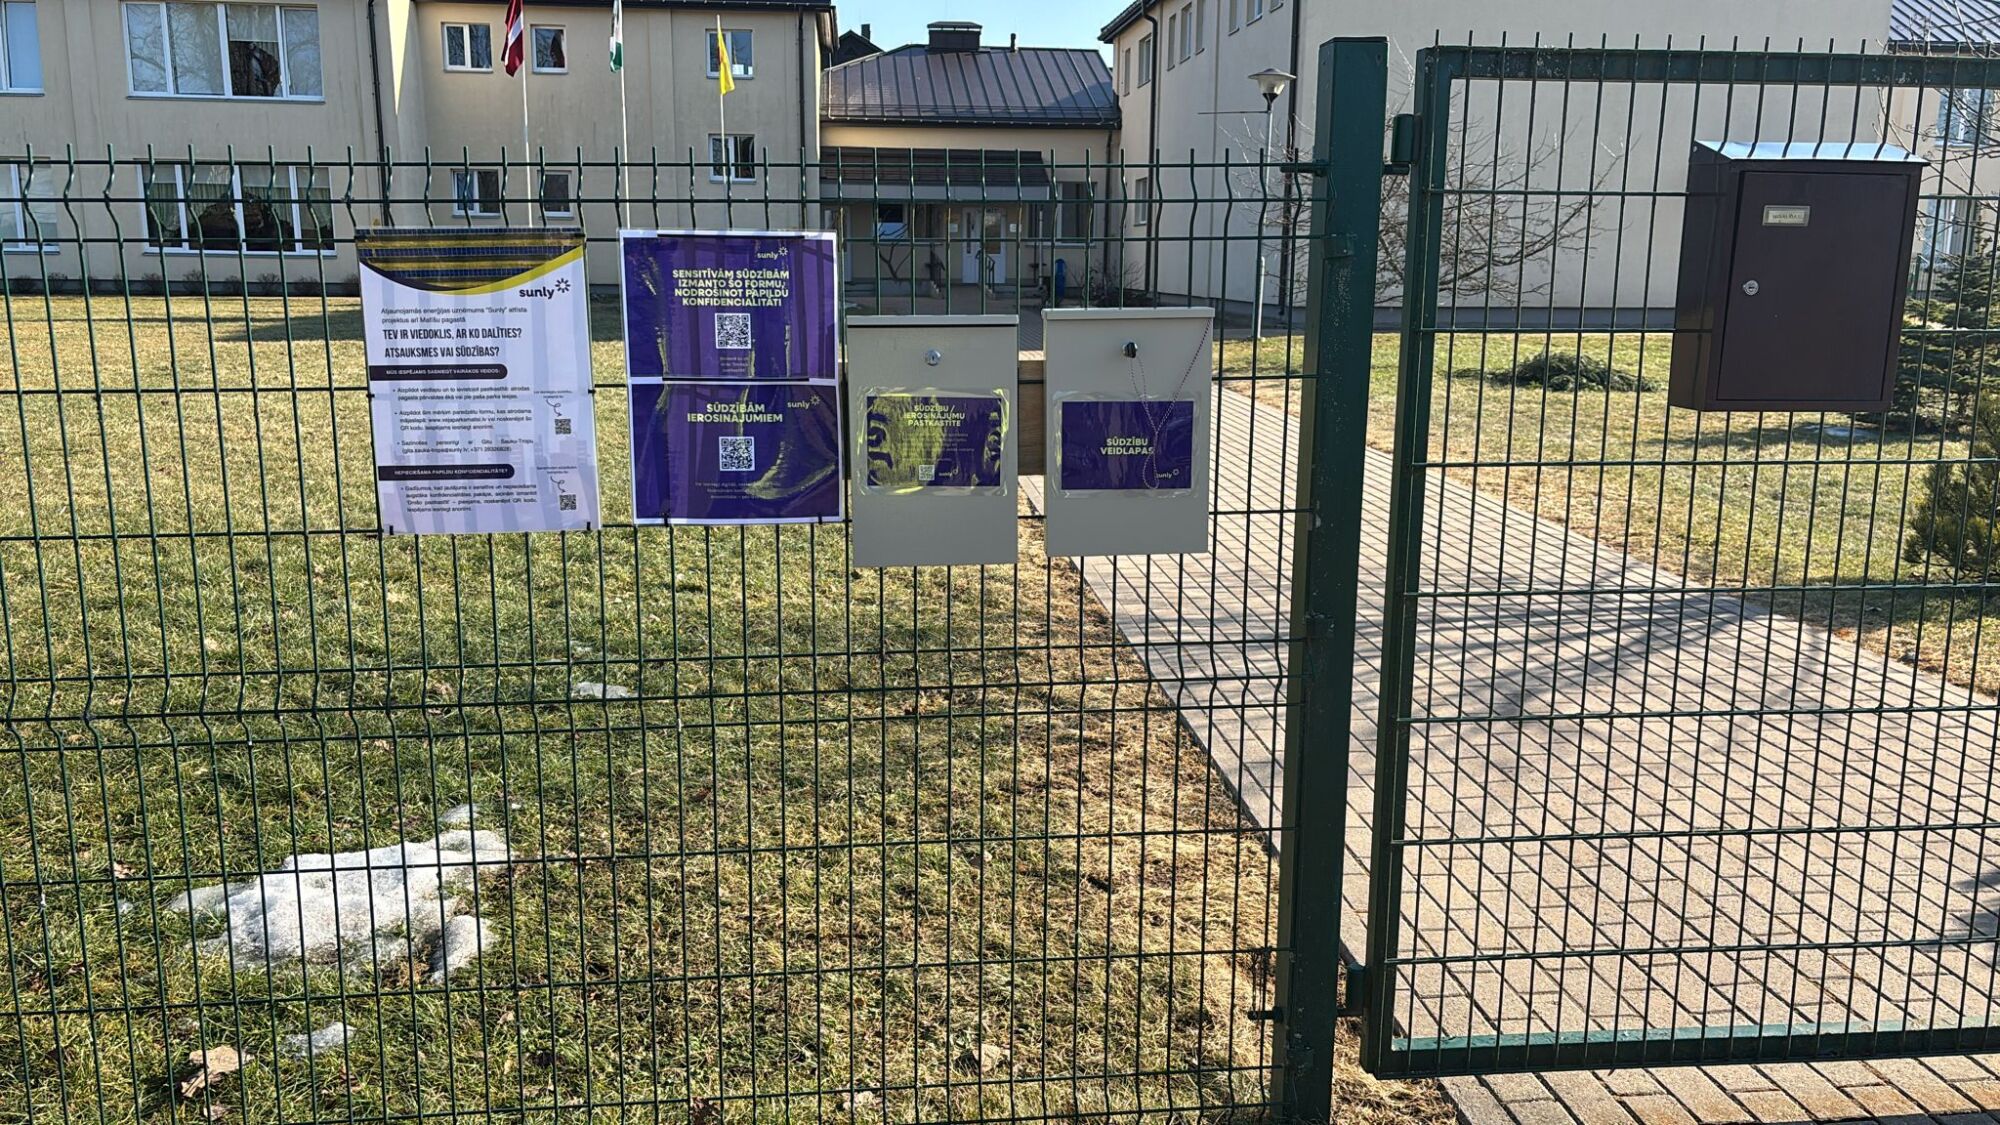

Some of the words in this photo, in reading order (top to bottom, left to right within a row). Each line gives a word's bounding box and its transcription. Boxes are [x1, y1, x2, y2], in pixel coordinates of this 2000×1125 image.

[758, 252, 778, 260] sunly
[673, 267, 734, 279] SENSITĪVĀM
[736, 267, 790, 279] SŪDZĪBĀM
[678, 280, 727, 288] IZMANTO
[728, 277, 743, 288] ŠO
[745, 280, 786, 289] FORMU,
[519, 286, 555, 300] sunly
[674, 286, 744, 297] NODROŠINOT
[746, 288, 789, 298] PAPILDU
[383, 329, 398, 340] TEV
[400, 329, 409, 339] IR
[410, 328, 455, 340] VIEDOKLIS,
[456, 328, 467, 339] AR
[469, 328, 480, 338] KO
[482, 326, 522, 338] DALĪTIES?
[385, 347, 439, 358] ATSAUKSMES
[440, 346, 454, 357] VAI
[455, 344, 500, 357] SŪDZĪBAS?
[787, 400, 811, 409] sunly
[1106, 436, 1149, 446] SŪDZĪBU
[1100, 447, 1155, 455] VEIDLAPAS
